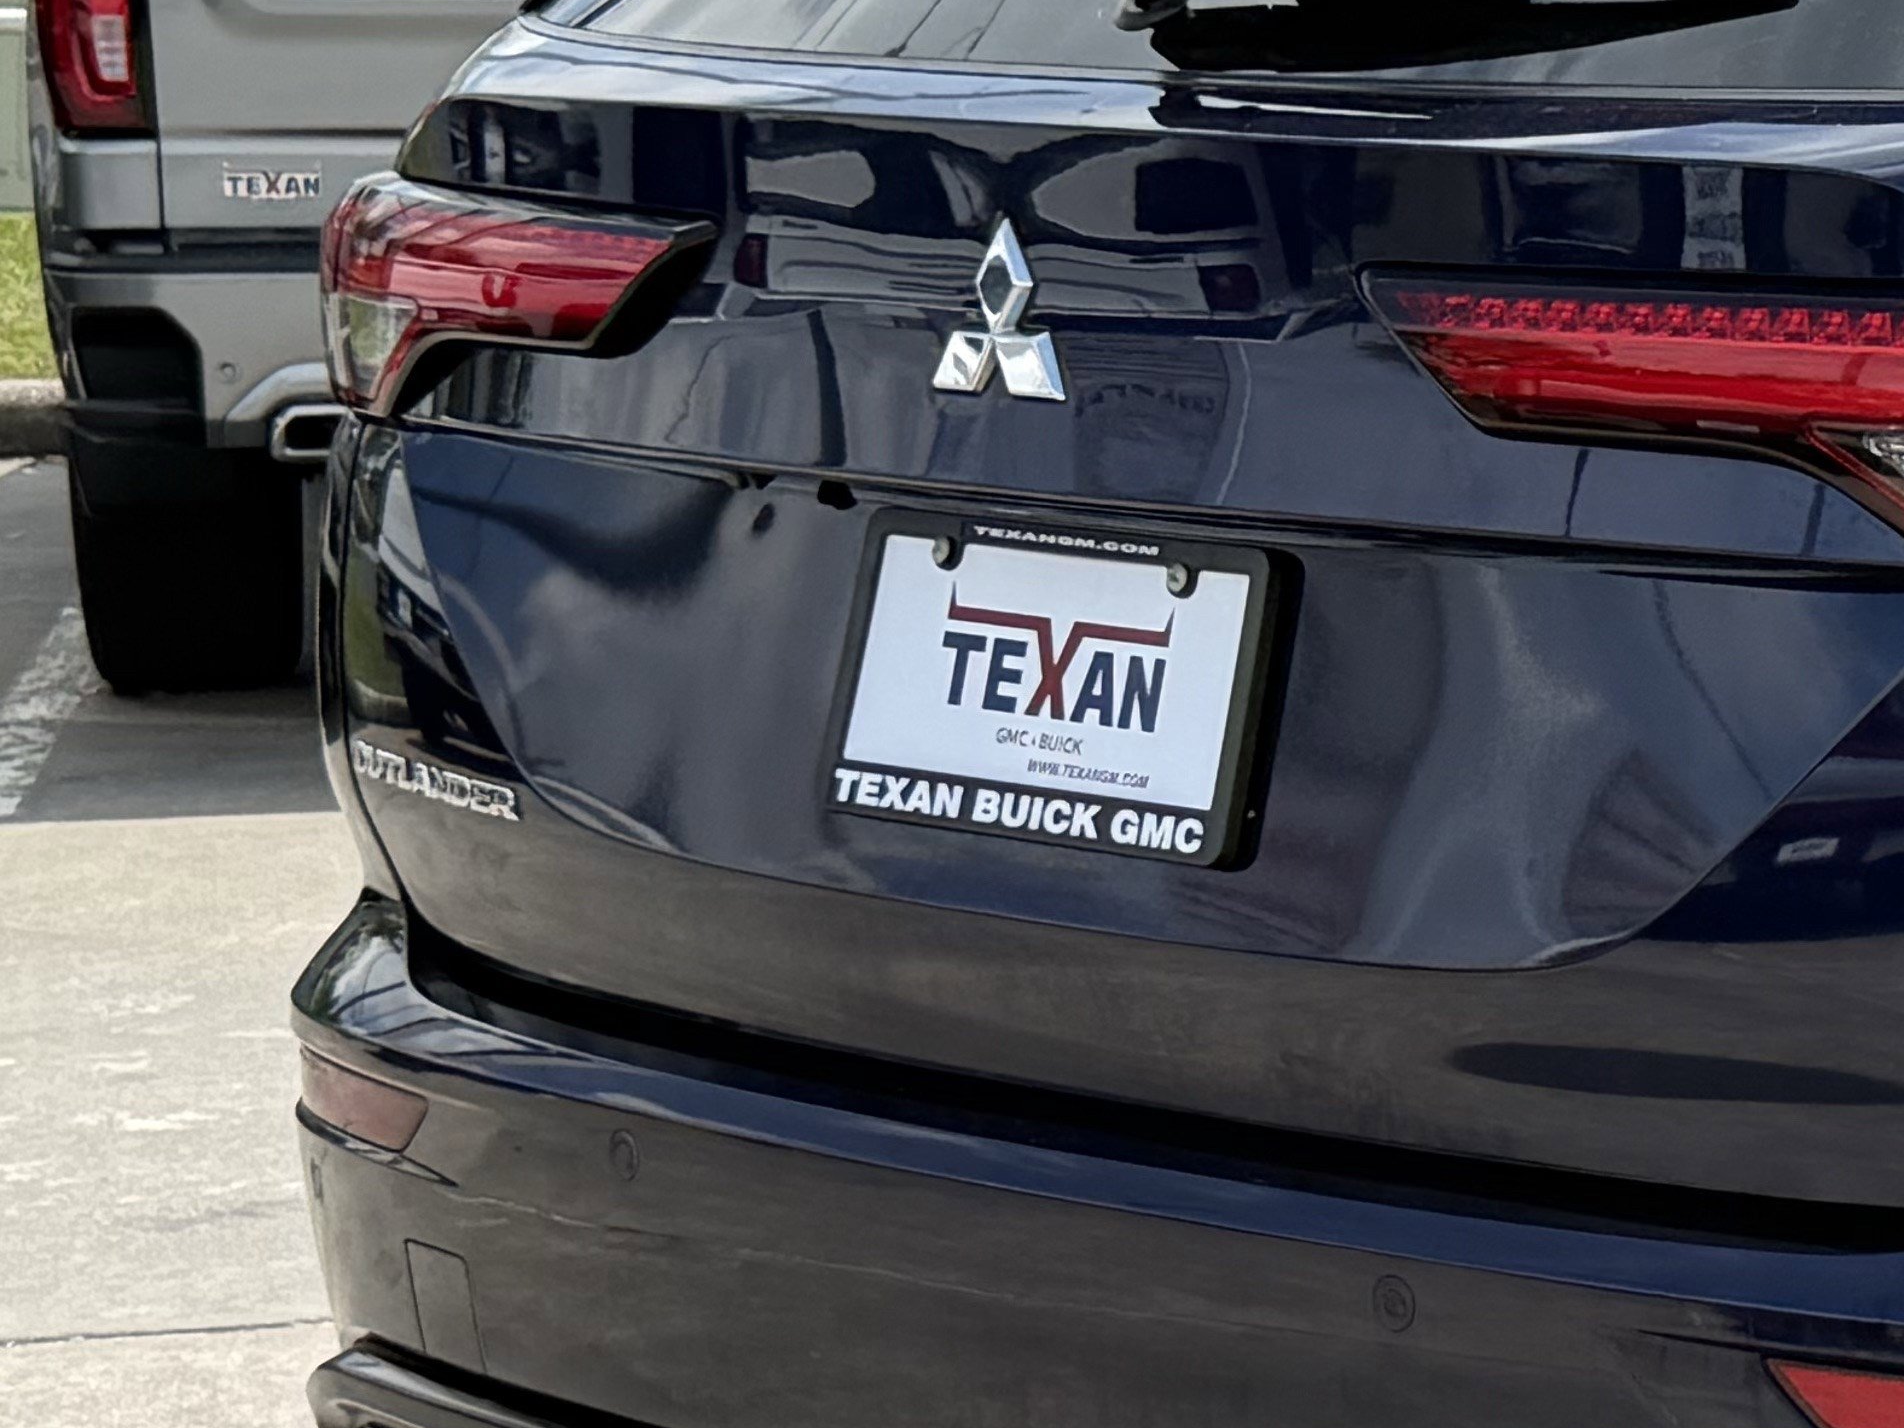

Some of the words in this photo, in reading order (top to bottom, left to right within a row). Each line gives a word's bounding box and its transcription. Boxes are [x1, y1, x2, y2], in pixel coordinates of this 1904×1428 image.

[223, 162, 321, 198] TEXAN
[974, 525, 1160, 556] TEXANGM.COM
[942, 581, 1175, 733] TEXAN
[996, 727, 1029, 747] GMC
[1039, 733, 1084, 755] BUICK
[351, 739, 520, 821] OUTLANDER
[834, 767, 964, 819] TEXAN
[972, 788, 1102, 840] BUICK
[1110, 809, 1204, 854] GMC
